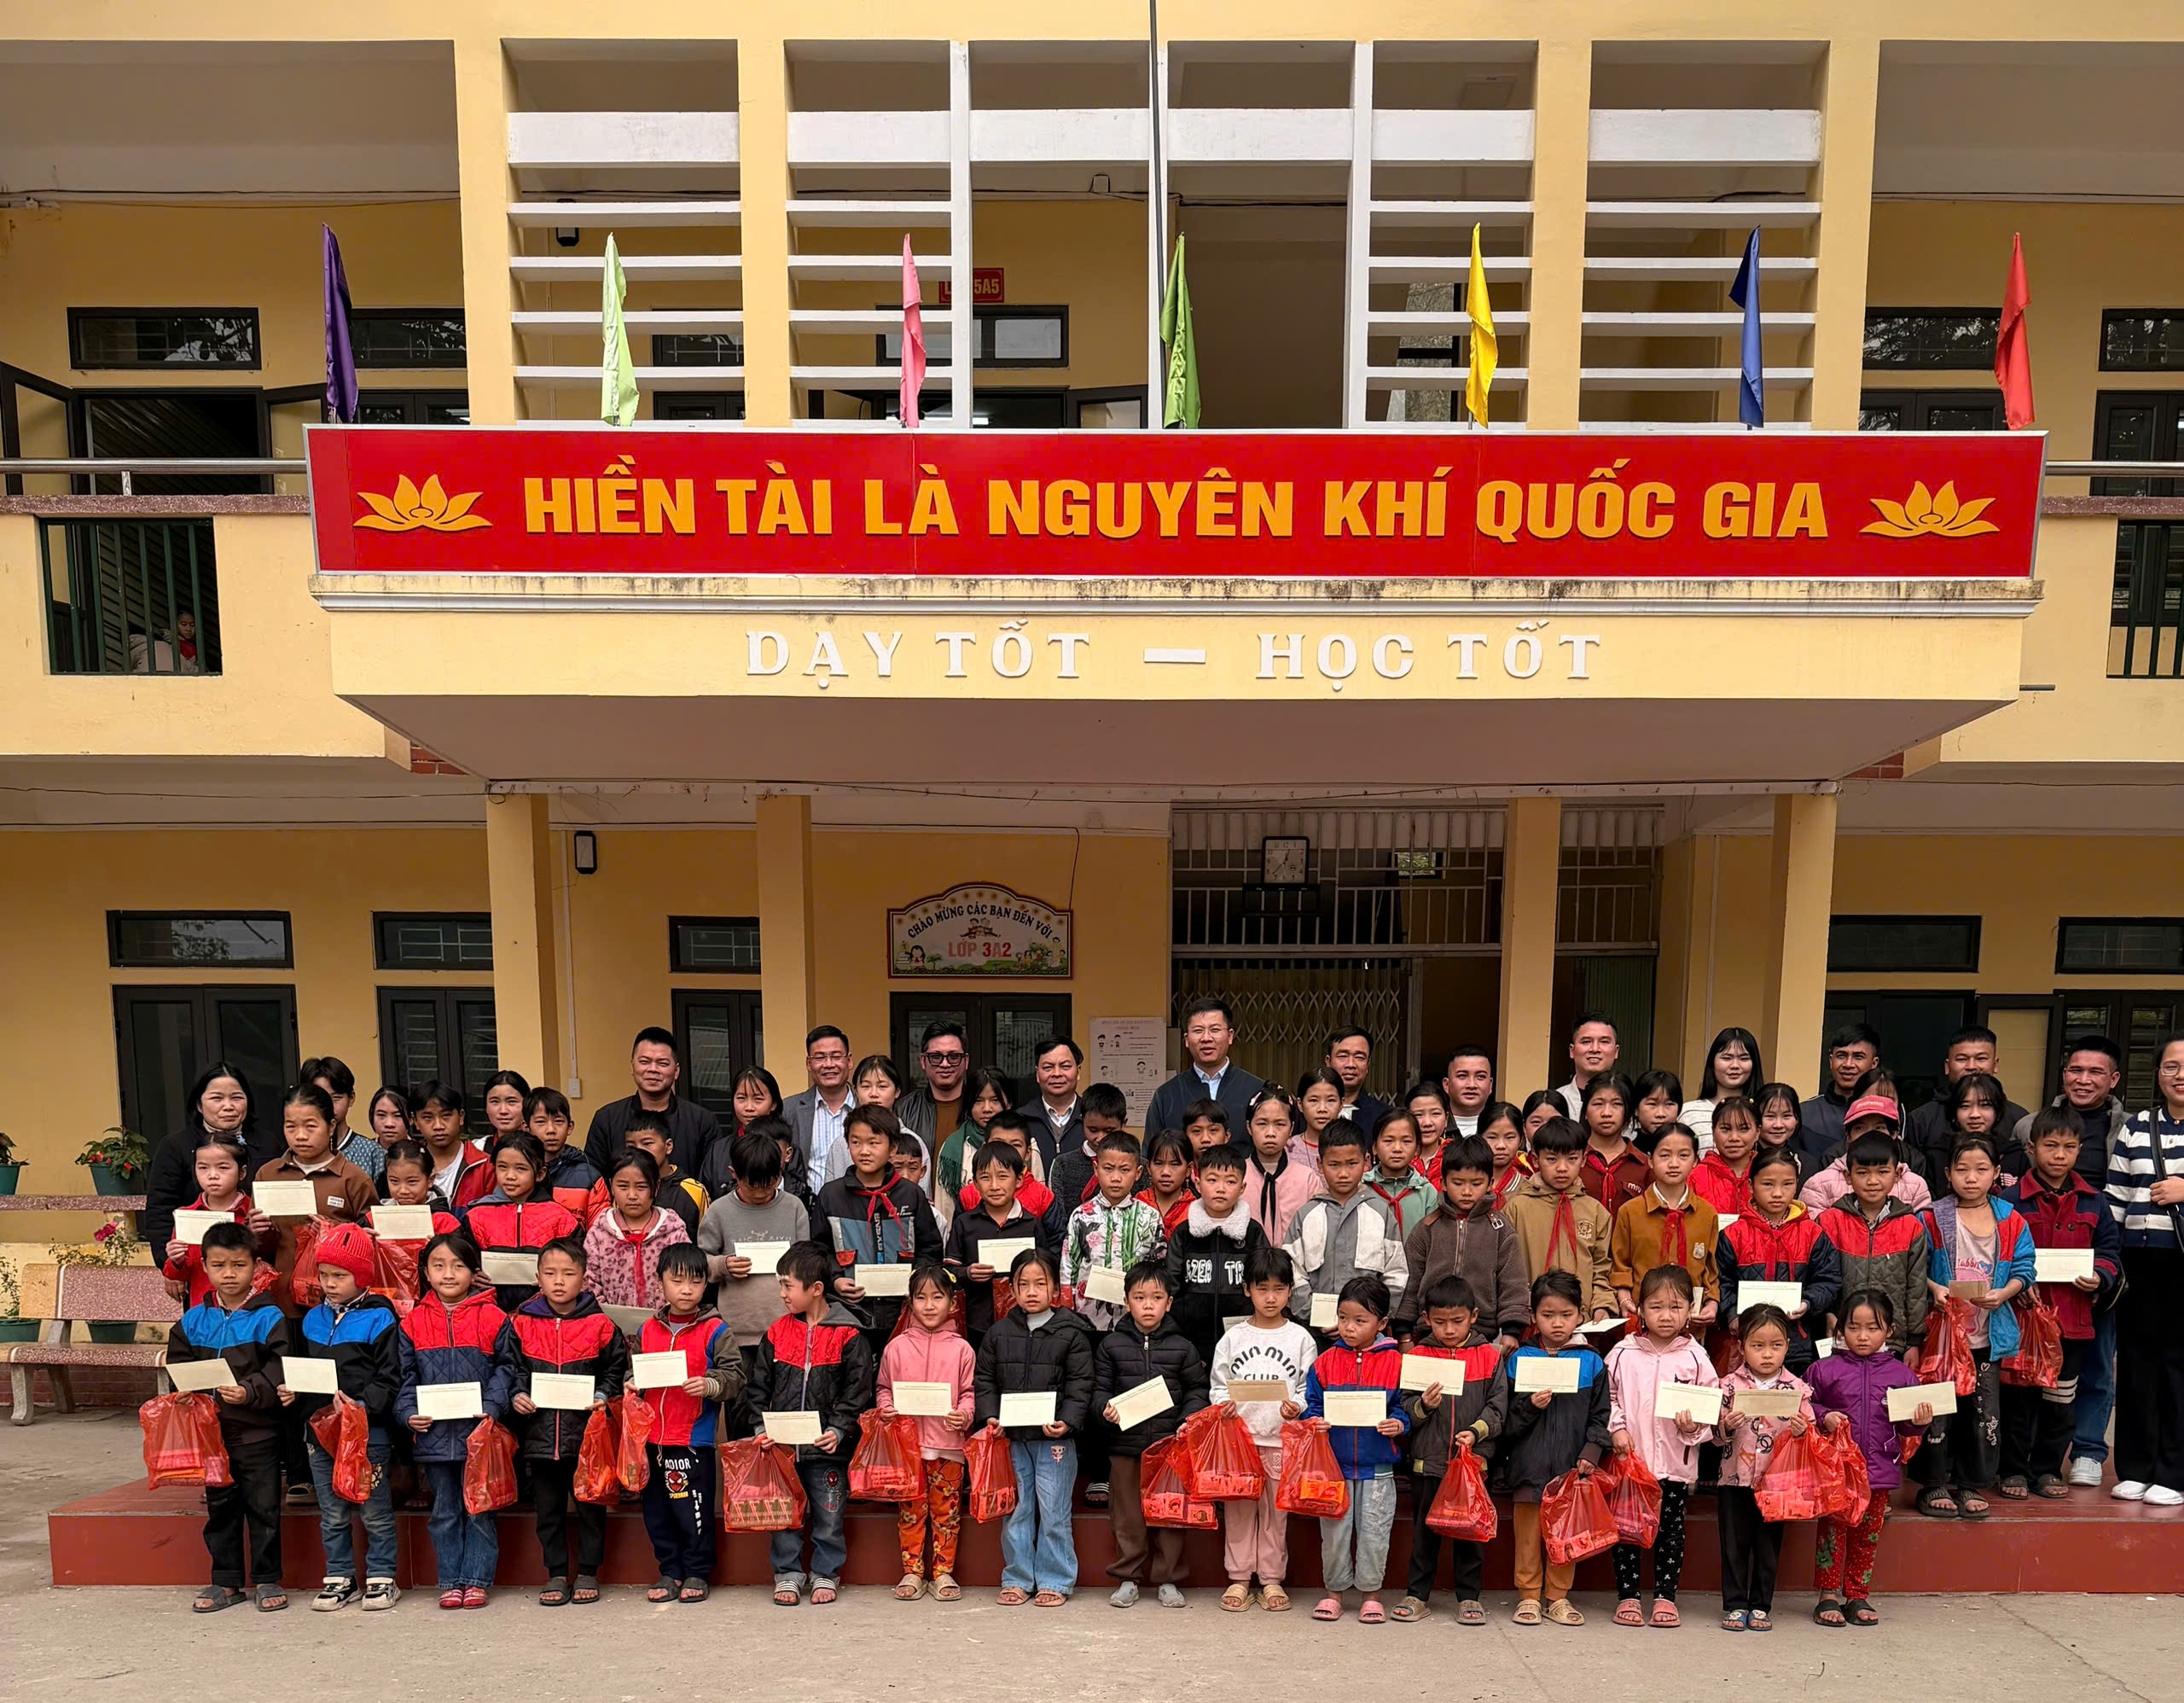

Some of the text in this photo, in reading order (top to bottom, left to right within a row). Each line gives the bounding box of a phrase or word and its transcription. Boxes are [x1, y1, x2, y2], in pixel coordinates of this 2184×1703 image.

[524, 455, 1828, 543] HIỀN TÀI LÀ NGUYÊN KHÍ QUỐC GIA
[746, 631, 903, 688] DẠY
[935, 619, 1089, 677] TỐT
[1258, 634, 1414, 690] HỌC
[1449, 620, 1600, 678] TỐT
[908, 915, 934, 939] CHÀO
[935, 904, 964, 923] MỪNG
[967, 901, 988, 915] CÁC
[990, 904, 1012, 920] BẠN
[1013, 910, 1034, 927] ĐẾN
[982, 942, 1013, 958] 3A2
